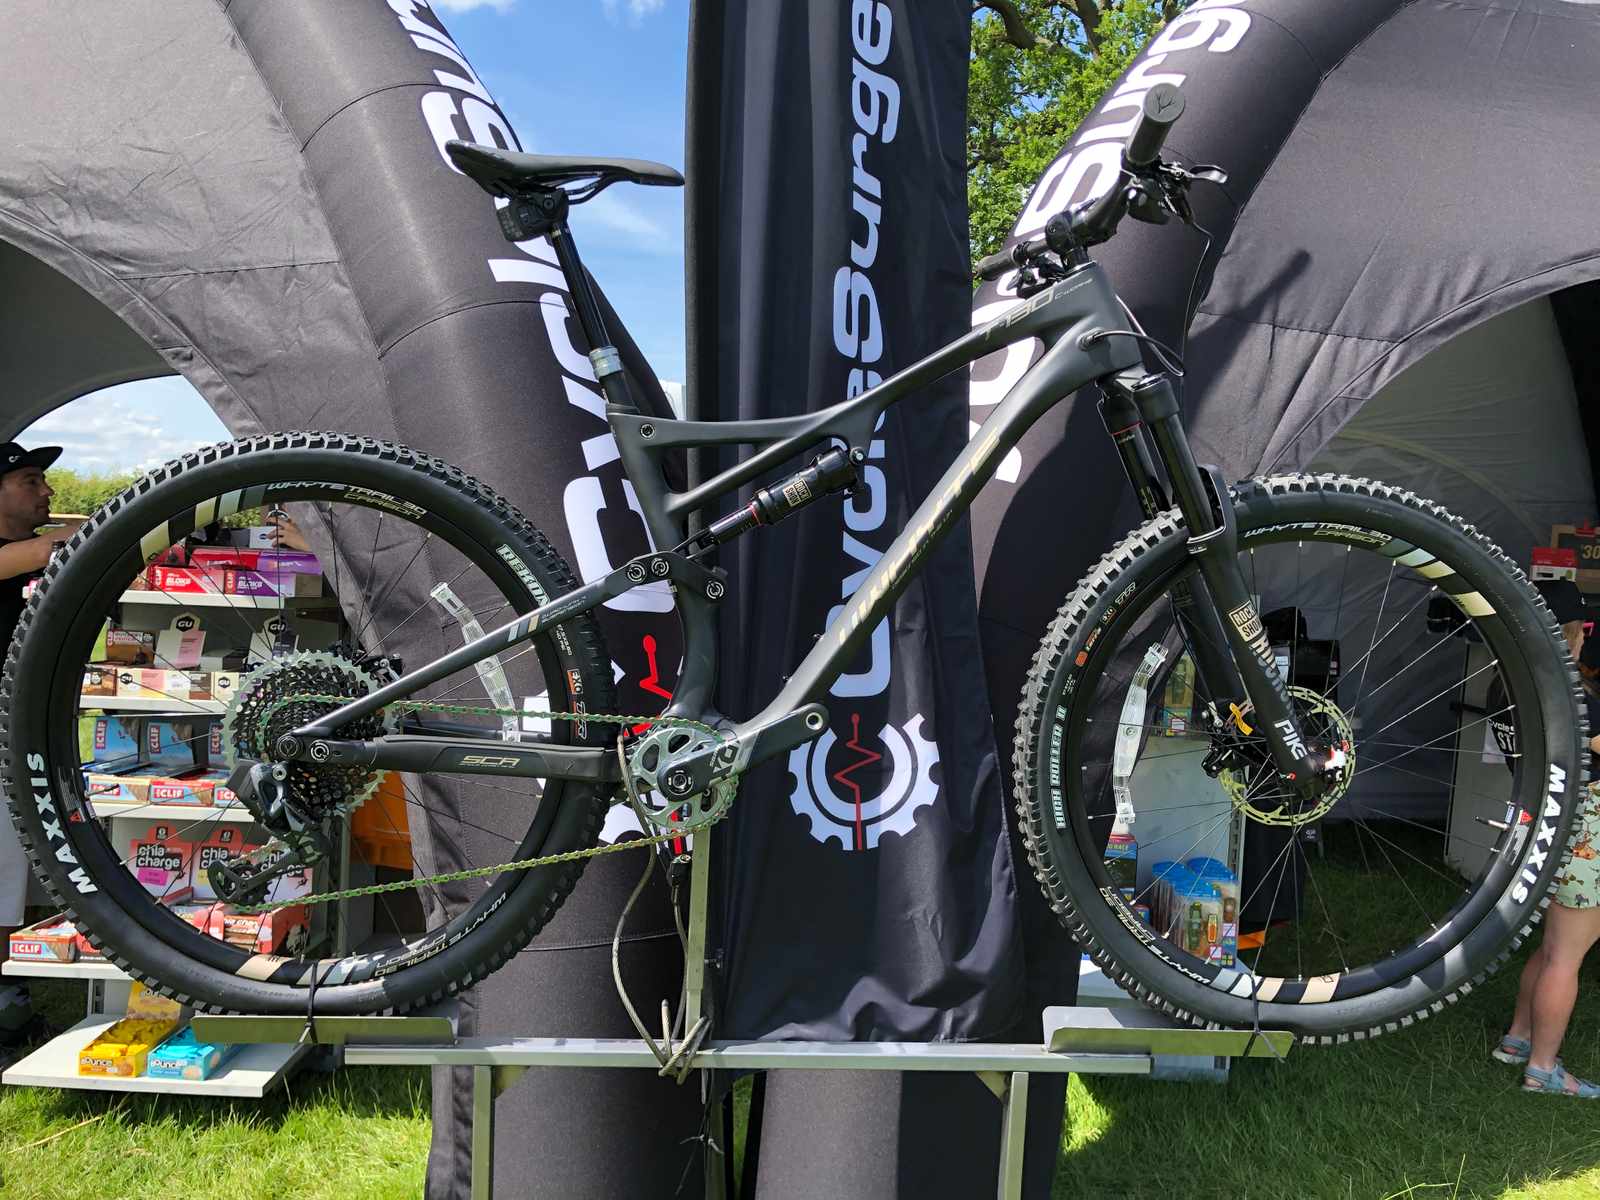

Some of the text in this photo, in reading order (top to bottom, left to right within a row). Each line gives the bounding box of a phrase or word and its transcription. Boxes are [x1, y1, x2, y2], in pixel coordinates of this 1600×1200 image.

[267, 480, 346, 491] WHYTE
[1244, 522, 1318, 538] WHYTE
[177, 620, 193, 629] GU
[1274, 719, 1308, 761] PIKE
[160, 789, 184, 799] CLIF
[26, 752, 99, 895] MAXXIS
[1512, 763, 1567, 904] MAXXIS
[138, 844, 165, 857] chia
[202, 847, 229, 860] chia
[137, 855, 181, 870] charge
[18, 944, 40, 954] CLIF
